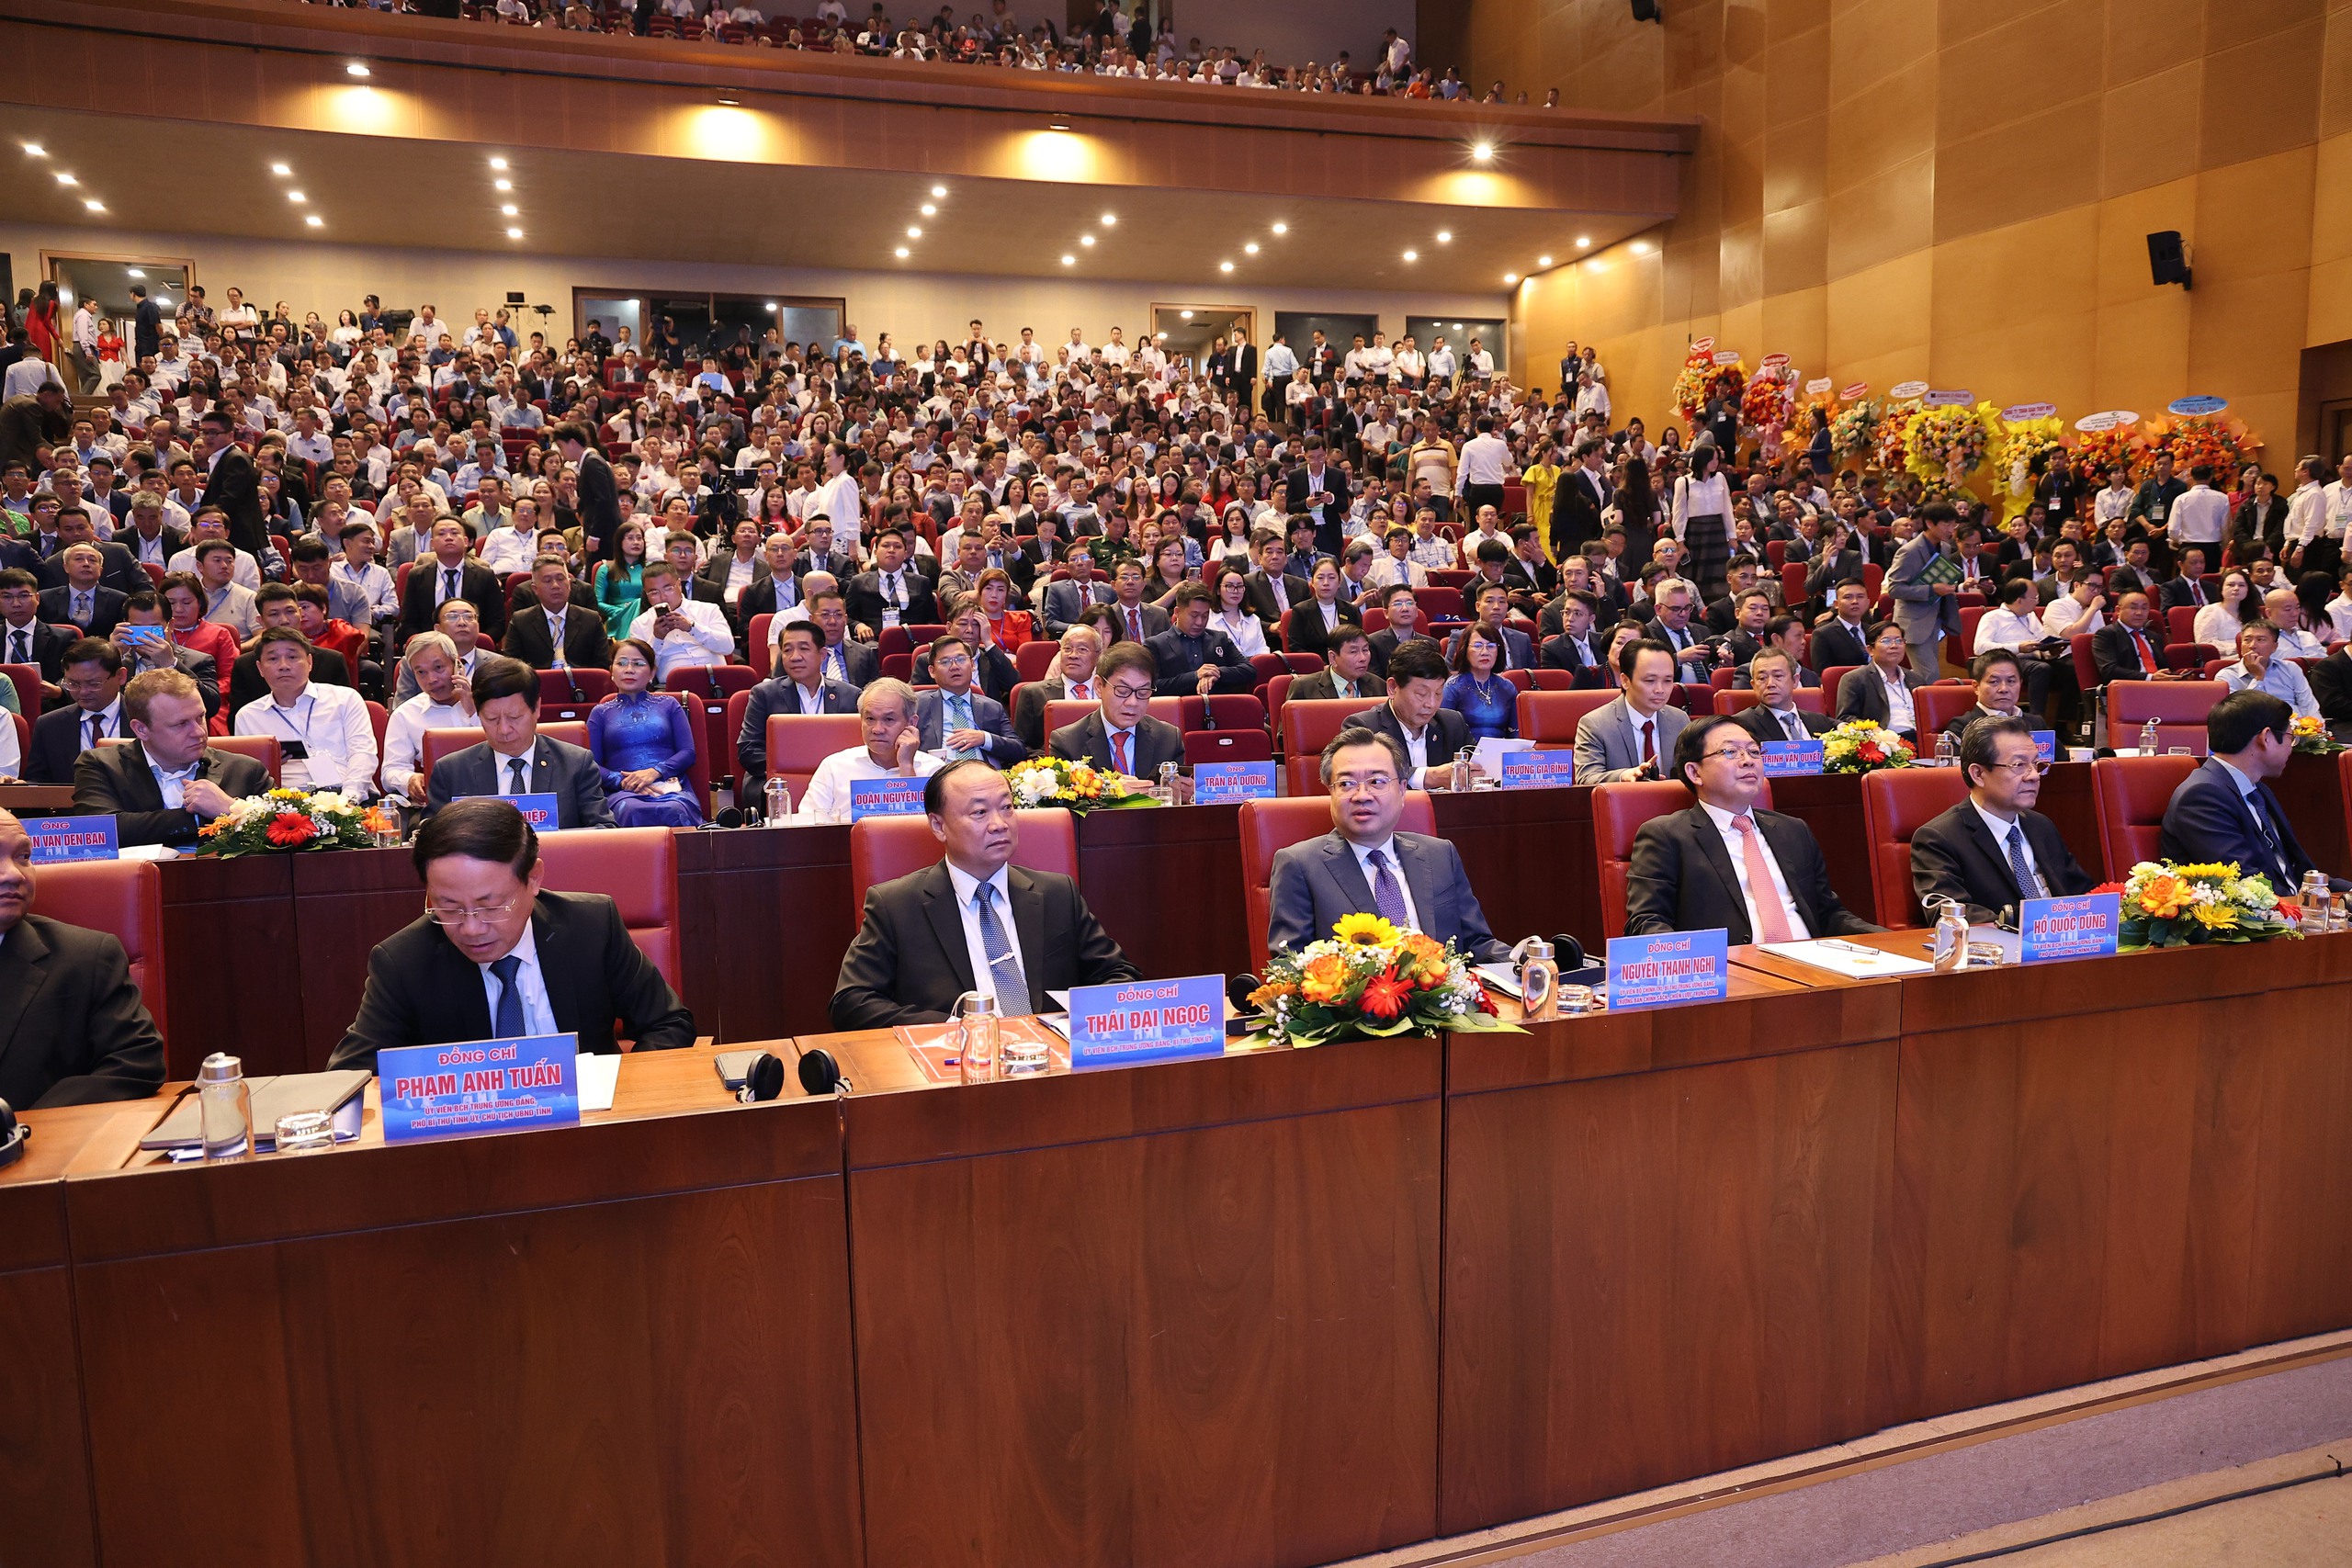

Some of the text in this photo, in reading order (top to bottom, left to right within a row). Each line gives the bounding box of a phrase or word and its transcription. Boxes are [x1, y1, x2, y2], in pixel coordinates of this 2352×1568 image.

[1226, 764, 1245, 773] ÔNG
[1506, 761, 1568, 776] TRƯƠNG GIA BÌNH
[886, 780, 908, 789] ÔNG
[1204, 773, 1267, 787] TRẦN BÁ DƯƠNG
[855, 790, 880, 806] ĐOÀN
[883, 789, 917, 805] NGUYÊN
[41, 821, 70, 830] ÔNG
[41, 834, 62, 847] VAN
[63, 833, 83, 846] DEN
[85, 832, 106, 845] BAN
[2052, 898, 2092, 912] ĐỒNG CHÍ
[2033, 911, 2107, 934] HỒ QUỐC DŨNG
[1647, 937, 1691, 953] ĐỒNG CHÍ
[1622, 956, 1659, 981] NGUYỄN
[1661, 958, 1690, 976] THANH
[1692, 955, 1715, 976] NGHỊ
[1117, 983, 1180, 1003] ĐỒNG CHÍ
[1086, 1003, 1211, 1035] THÁI ĐẠI NGỌC
[438, 1043, 517, 1066] ĐỒNG CHÍ
[395, 1057, 562, 1100] PHẠM ANH TUẤN
[424, 1105, 435, 1115] ỦY
[435, 1104, 452, 1114] VIÊN
[454, 1104, 469, 1113] BCH
[469, 1101, 493, 1111] TRUNG
[494, 1099, 514, 1109] ƯƠNG
[411, 1118, 426, 1129] PHÓ
[427, 1117, 436, 1127] BÍ
[436, 1116, 451, 1126] THƯ
[452, 1113, 469, 1124] TỈNH
[481, 1111, 496, 1122] CHỦ
[497, 1111, 514, 1122] TỊCH
[514, 1109, 534, 1119] UBND
[535, 1106, 553, 1117] TỈNH
